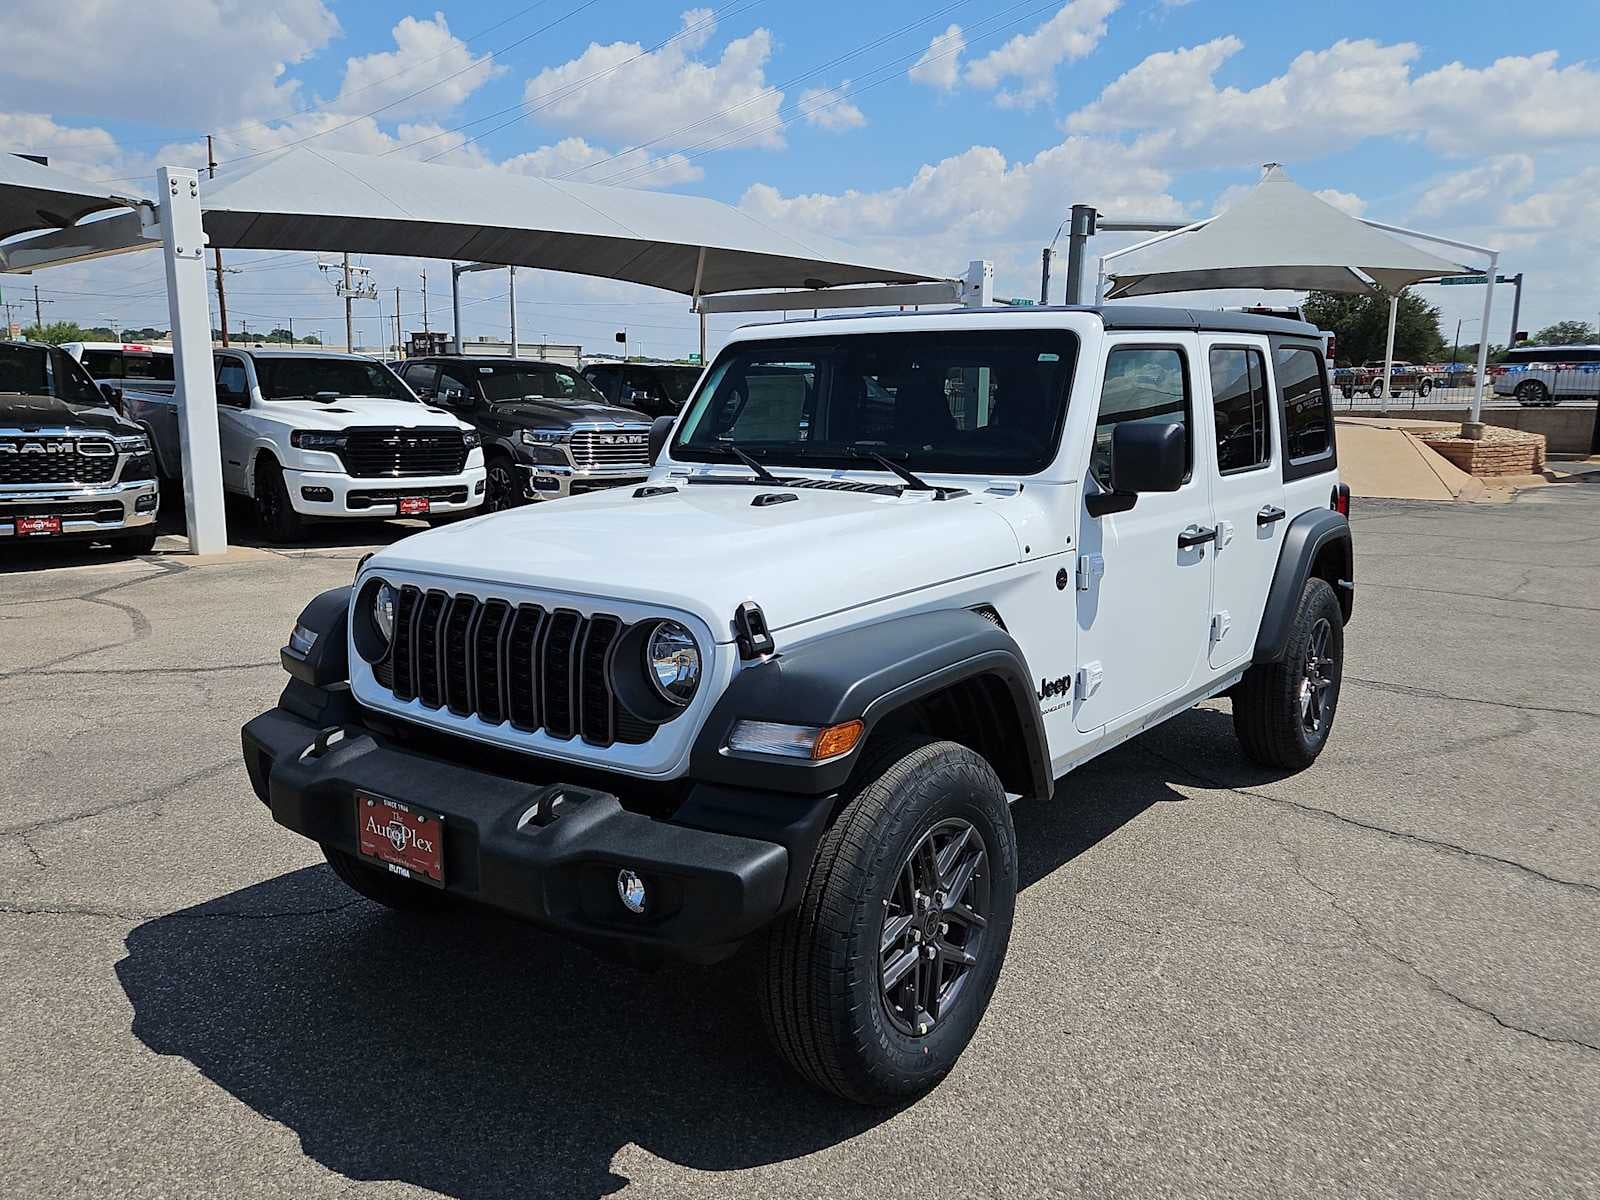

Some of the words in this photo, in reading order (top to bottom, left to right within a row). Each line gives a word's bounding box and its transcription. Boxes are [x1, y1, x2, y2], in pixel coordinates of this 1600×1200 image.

[600, 434, 642, 444] RAM
[21, 520, 57, 530] AutoPlex
[1037, 674, 1071, 701] Jeep
[391, 811, 403, 822] The
[366, 816, 433, 852] AutoPlex
